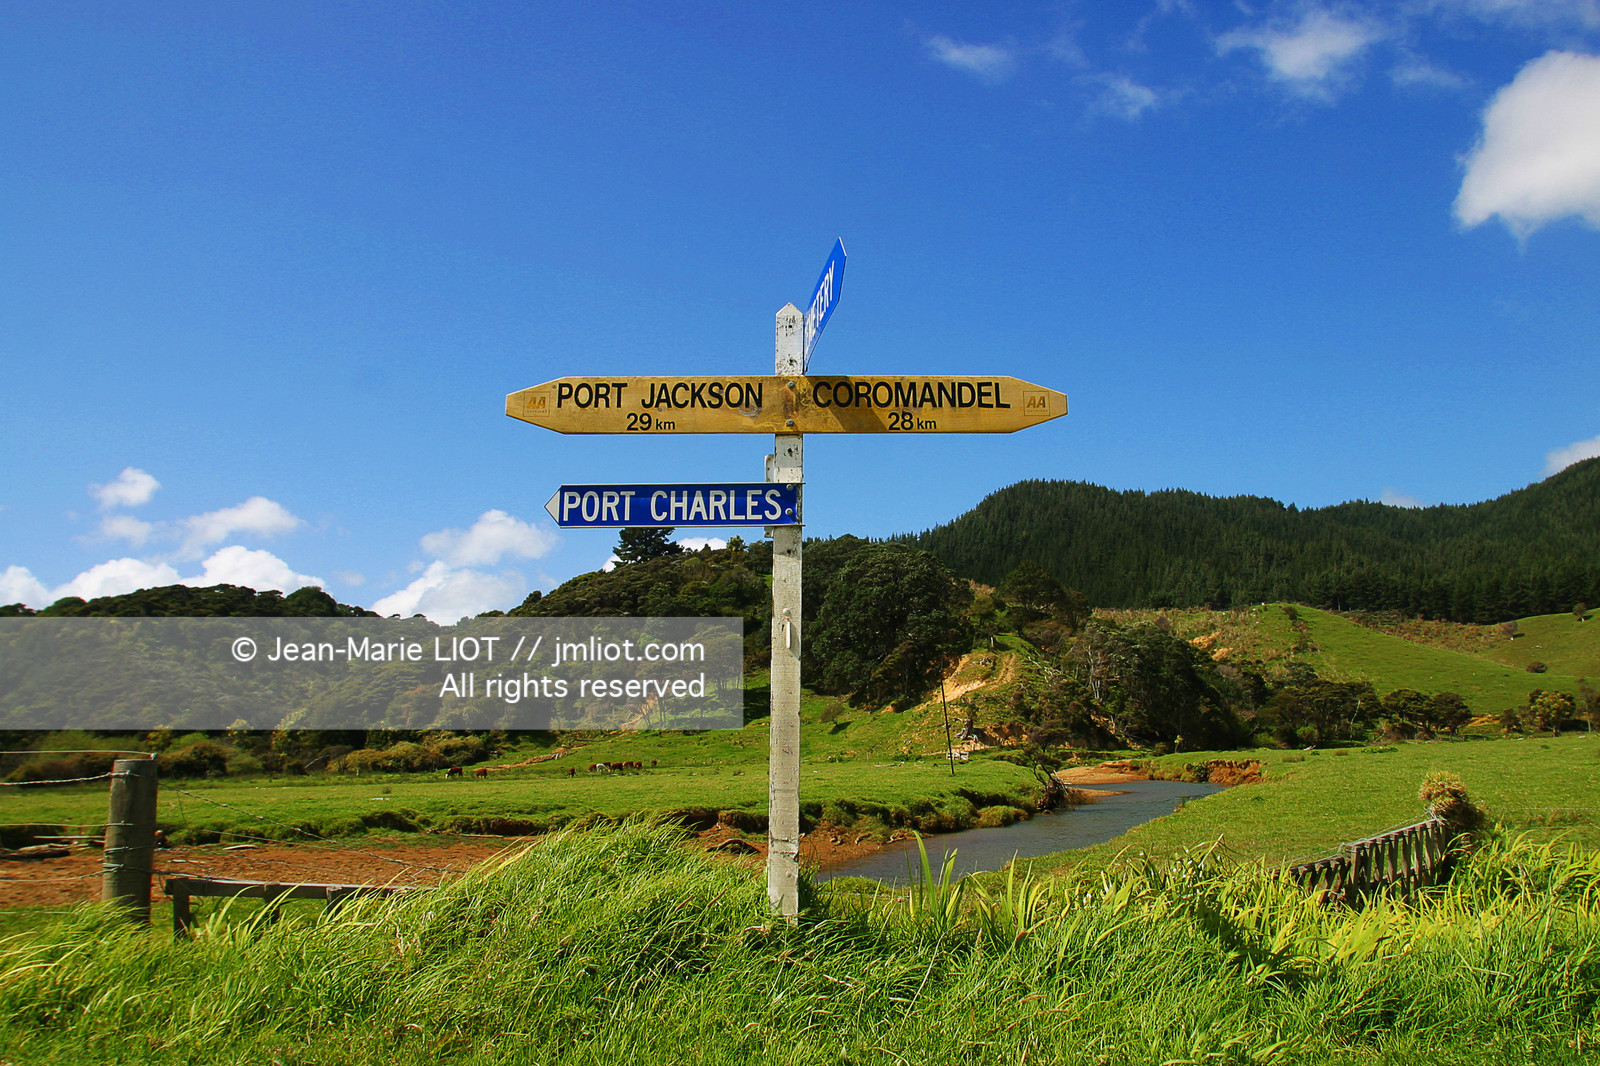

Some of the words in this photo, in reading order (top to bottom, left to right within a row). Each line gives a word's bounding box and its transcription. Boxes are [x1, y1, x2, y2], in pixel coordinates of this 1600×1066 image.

[526, 396, 547, 409] AA
[557, 382, 628, 409] PORT
[641, 382, 763, 409] JACKSON
[812, 381, 1011, 409] COROMANDEL
[1026, 395, 1046, 408] AA
[626, 412, 652, 431] 29
[655, 418, 676, 431] km
[887, 411, 914, 431] 28
[916, 417, 937, 430] km
[563, 491, 636, 522] PORT
[650, 489, 782, 521] CHARLES
